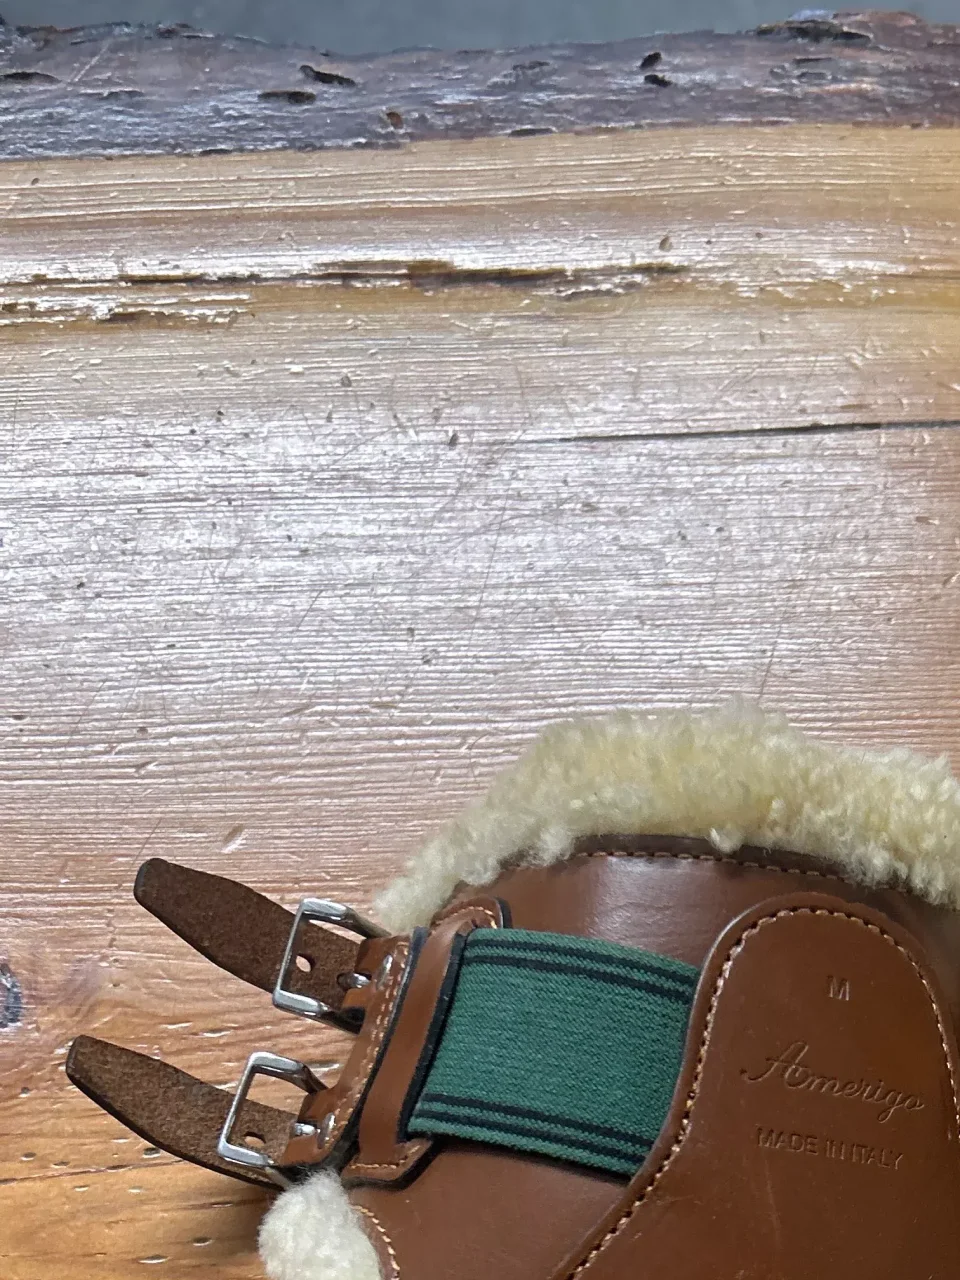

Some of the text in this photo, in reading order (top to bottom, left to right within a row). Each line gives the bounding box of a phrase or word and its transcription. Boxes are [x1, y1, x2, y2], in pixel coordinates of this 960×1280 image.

[828, 975, 850, 1001] M
[740, 1042, 925, 1123] Amerigo
[756, 1126, 904, 1170] MADE IN ITALY
